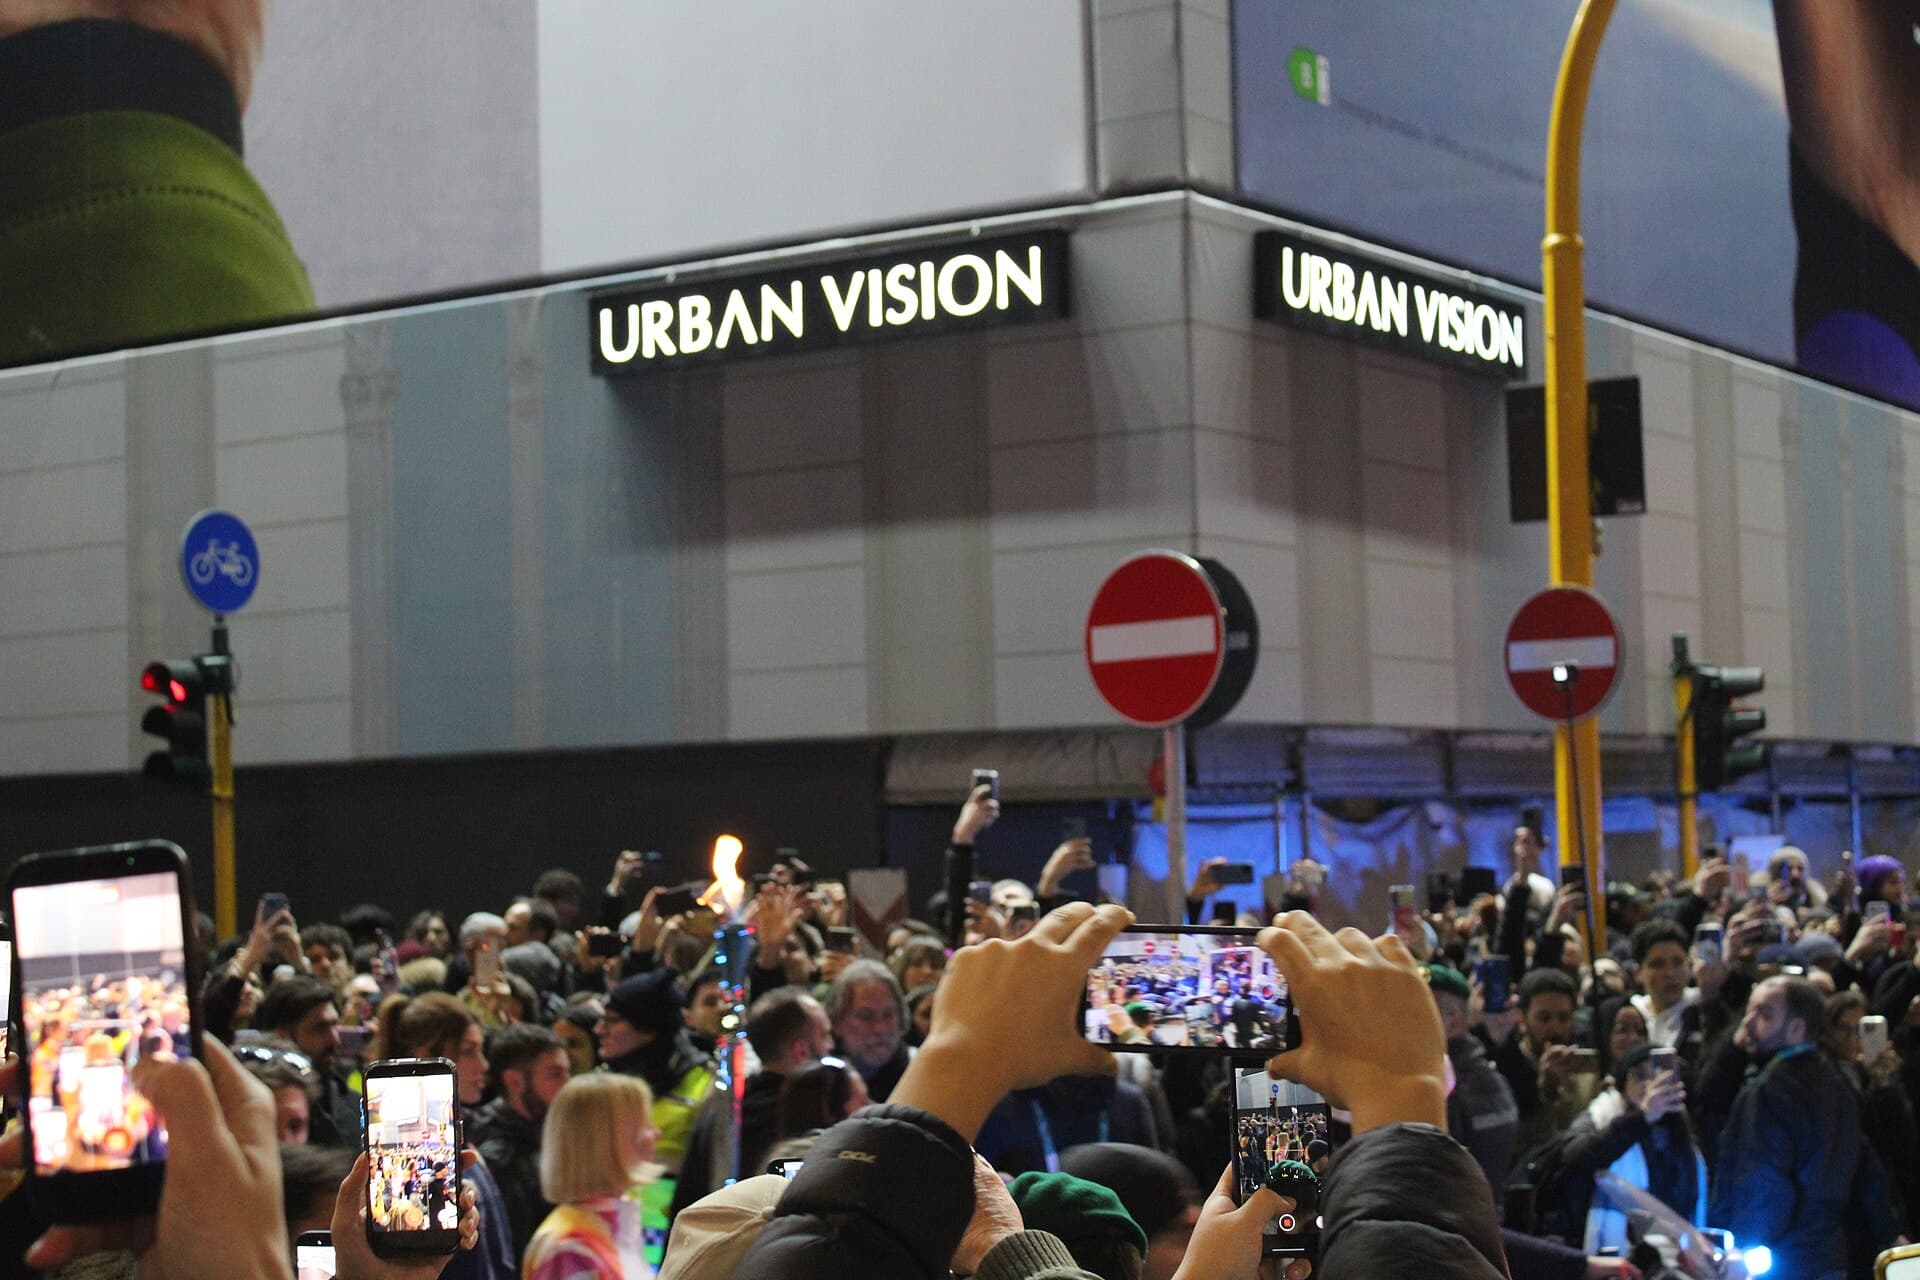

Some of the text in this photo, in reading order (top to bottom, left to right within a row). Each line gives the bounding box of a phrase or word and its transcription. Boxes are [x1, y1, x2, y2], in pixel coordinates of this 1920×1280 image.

[600, 245, 1042, 363] URBAN VISION
[1282, 246, 1524, 368] URBAN VISION
